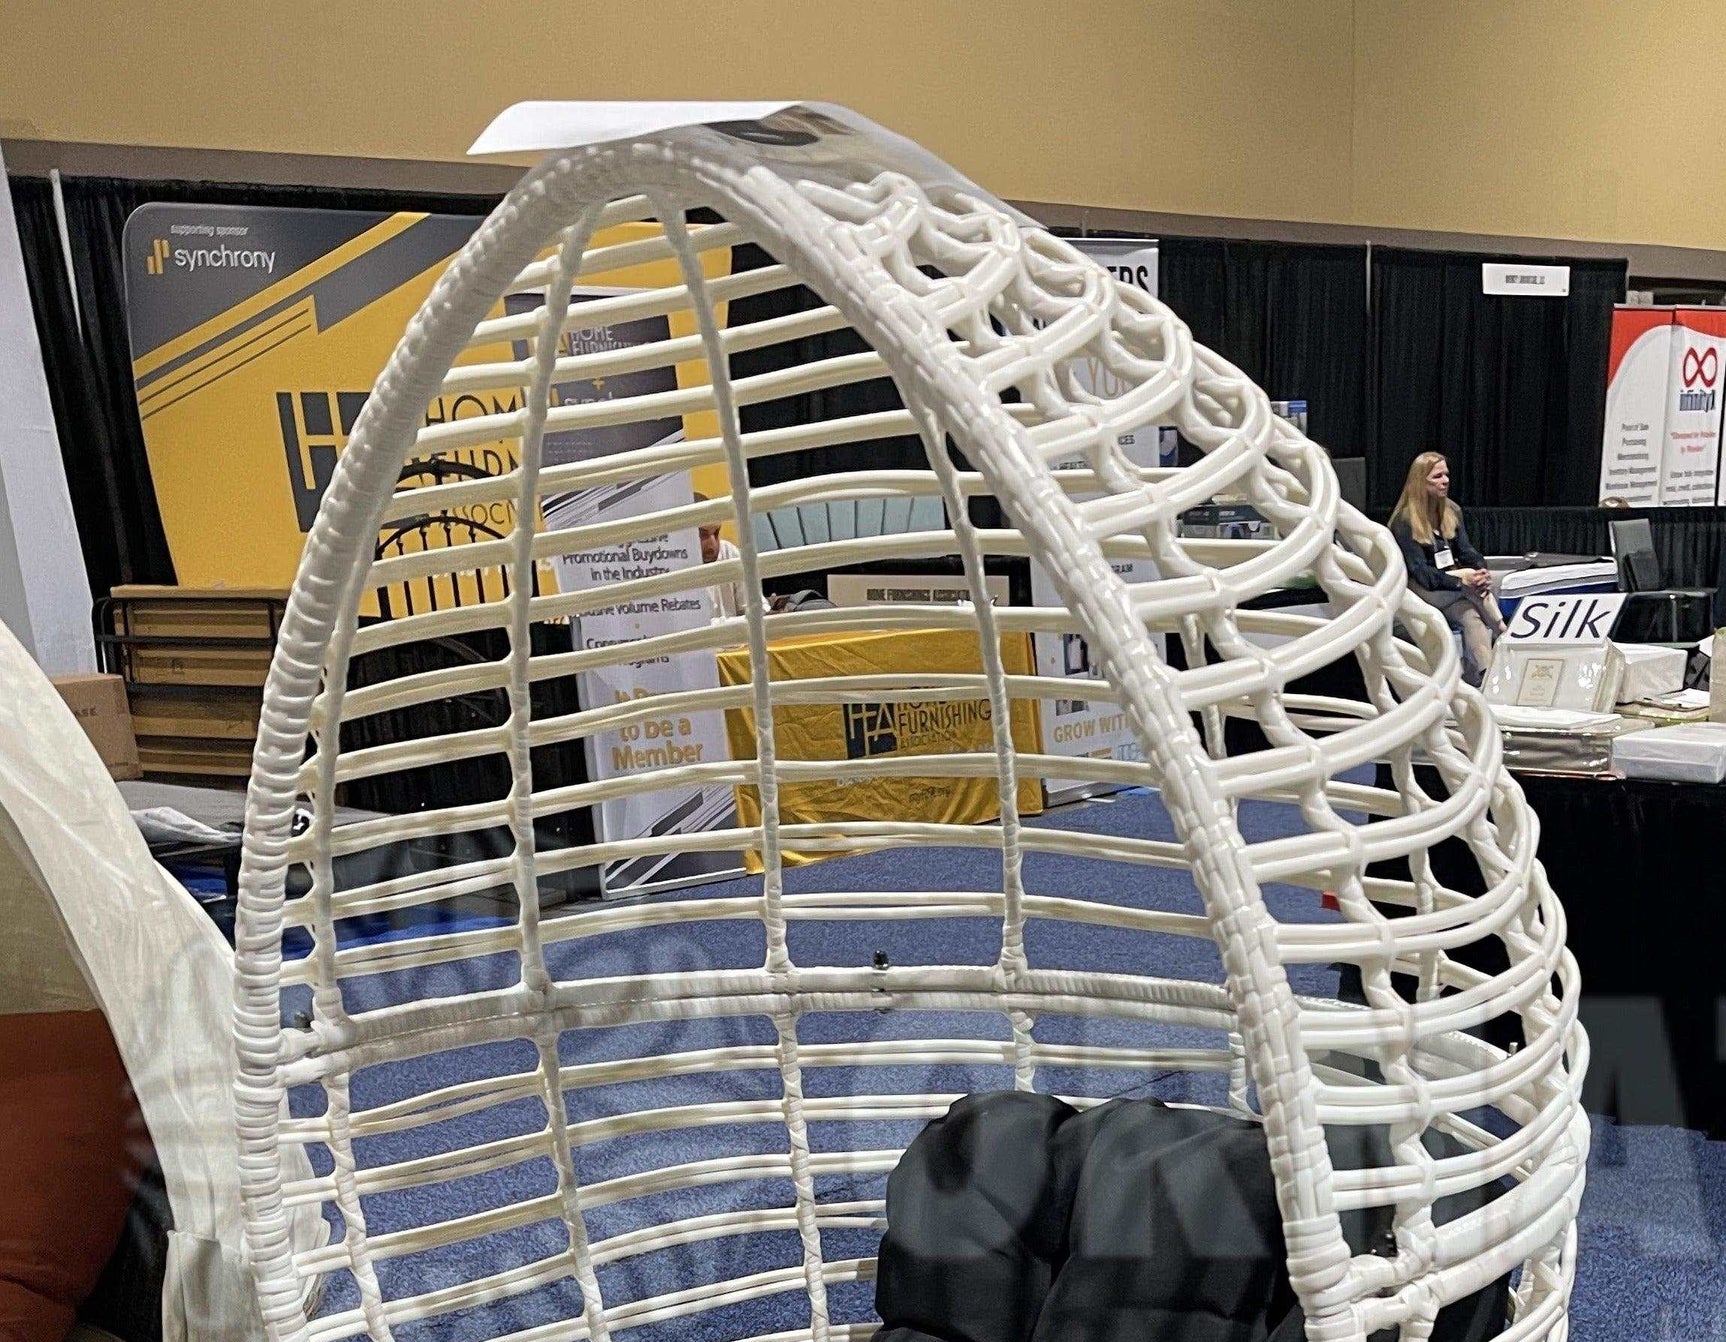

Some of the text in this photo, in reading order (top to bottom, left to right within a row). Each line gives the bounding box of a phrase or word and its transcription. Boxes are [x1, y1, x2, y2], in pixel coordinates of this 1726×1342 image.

[174, 243, 276, 275] synchrony
[562, 549, 630, 566] Promotional
[633, 547, 689, 565] Buydowns
[661, 598, 702, 612] Rebates
[1510, 599, 1612, 639] Silk
[678, 717, 692, 736] a
[1053, 720, 1096, 743] GROW
[611, 739, 703, 771] Member
